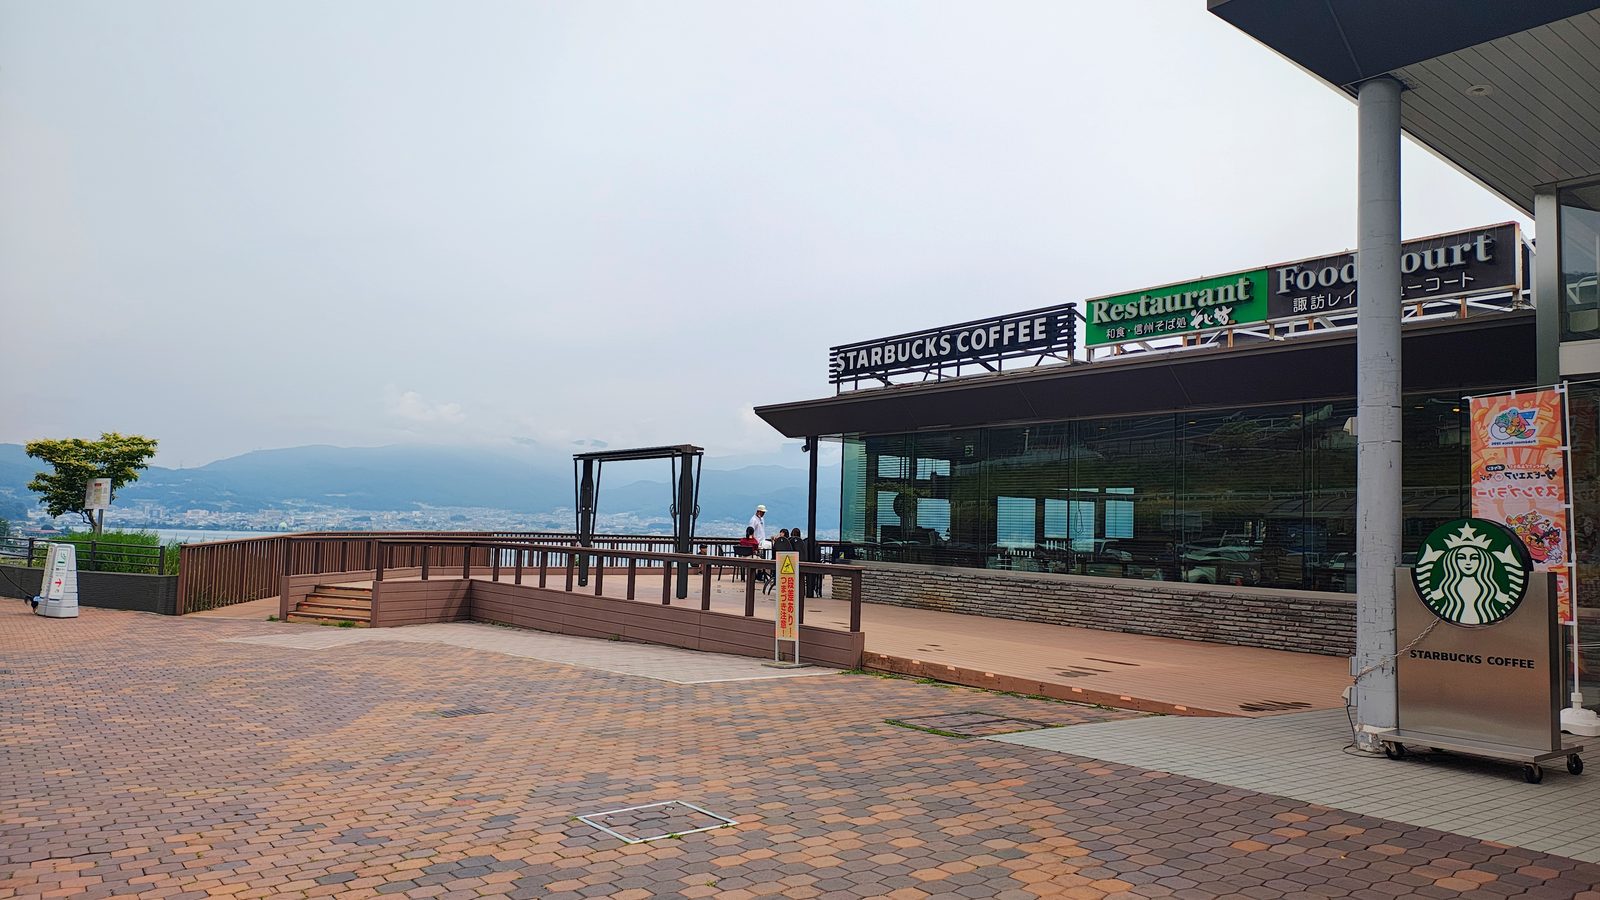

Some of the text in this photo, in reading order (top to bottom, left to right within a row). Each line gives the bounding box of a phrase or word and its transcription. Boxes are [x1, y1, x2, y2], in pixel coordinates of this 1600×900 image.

[1276, 234, 1492, 295] Food ourt
[1092, 277, 1250, 324] Restaurant
[836, 317, 1047, 372] STARBUCKS COFFEE
[1106, 317, 1187, 339] 和食・信州そば処
[1410, 650, 1535, 669] STARBUCKS COFFEE
